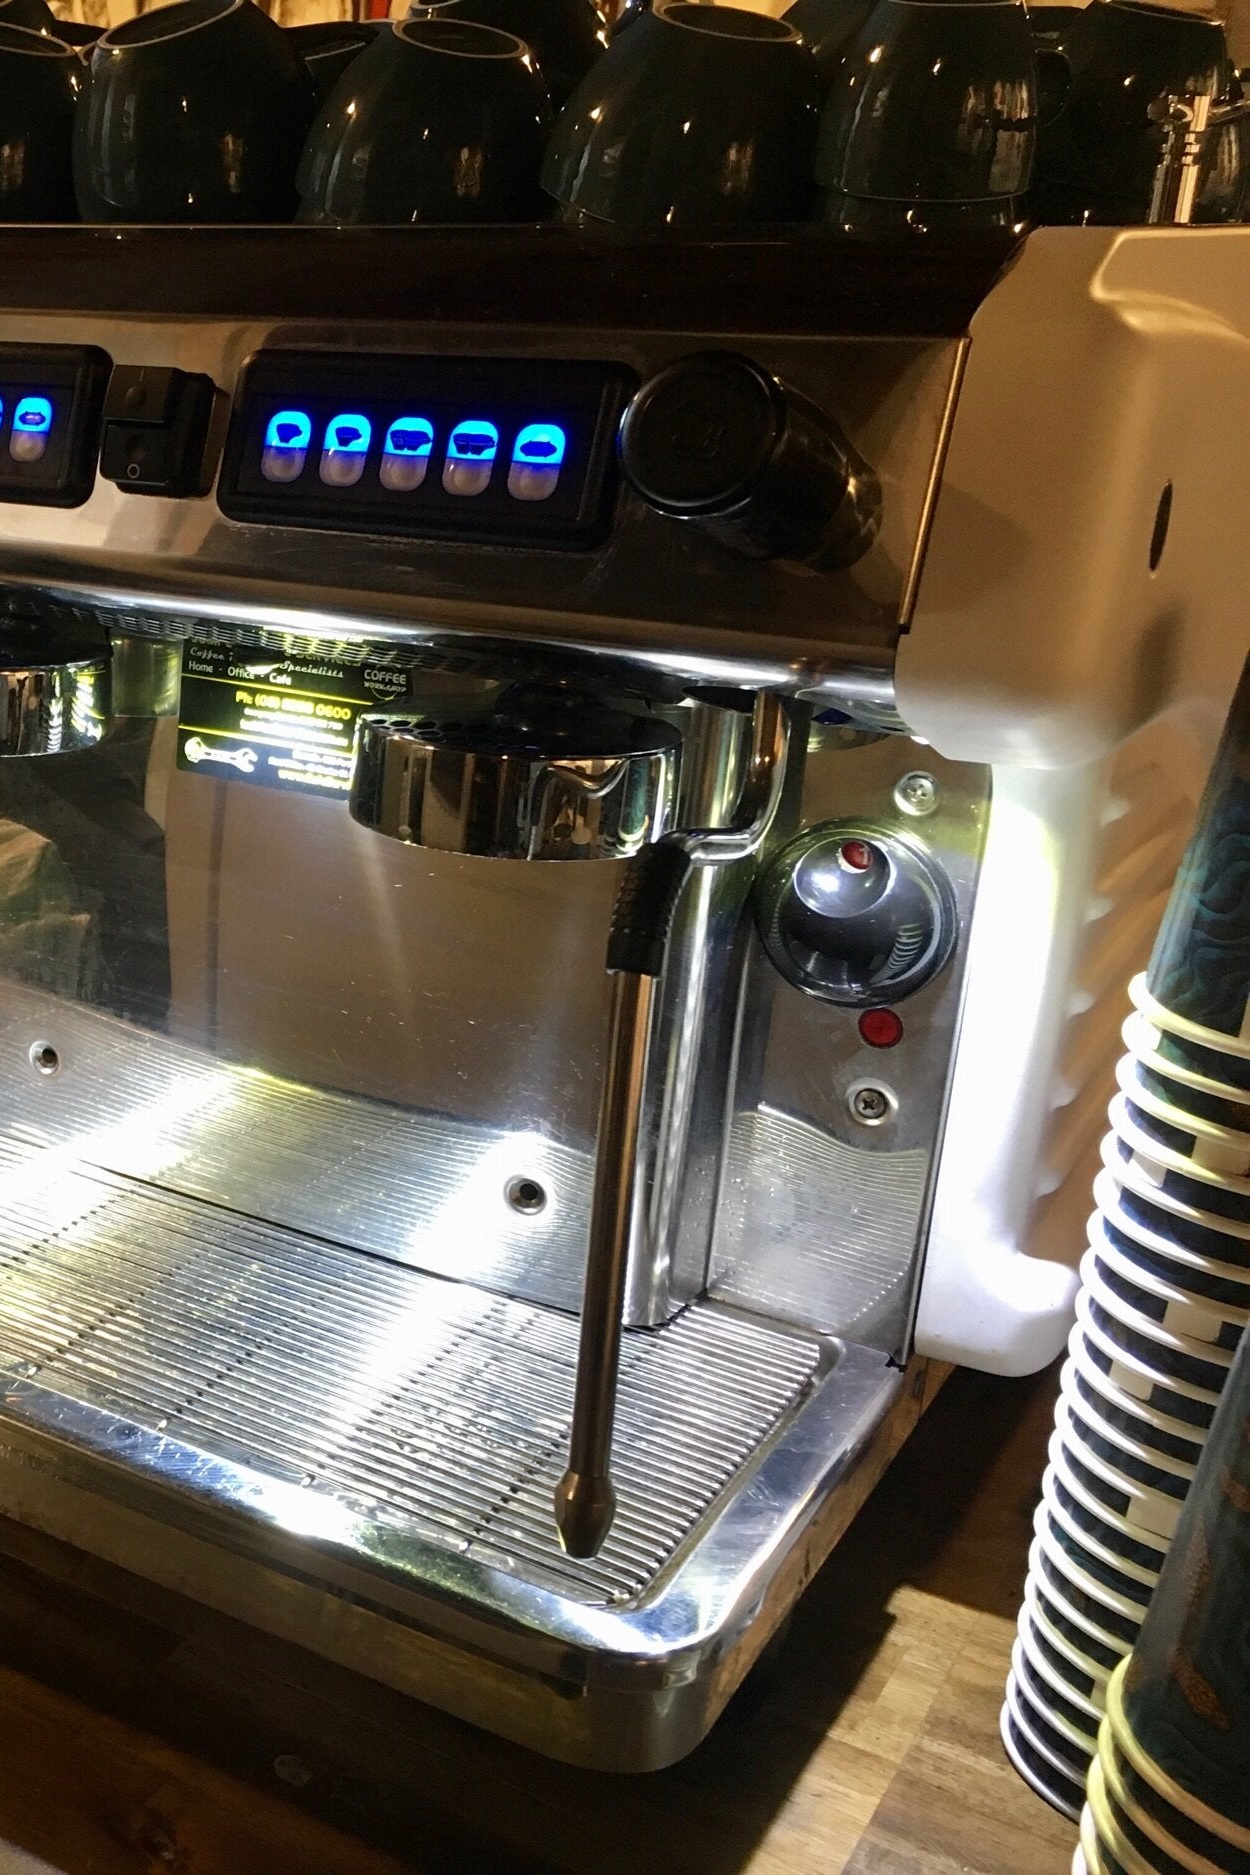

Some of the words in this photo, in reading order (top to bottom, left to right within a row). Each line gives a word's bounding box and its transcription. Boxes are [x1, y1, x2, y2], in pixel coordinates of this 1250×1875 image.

[188, 660, 214, 674] Home
[227, 665, 255, 680] Office
[279, 660, 344, 678] Specialists
[364, 669, 407, 685] COFFEE
[315, 703, 352, 720] 0600
